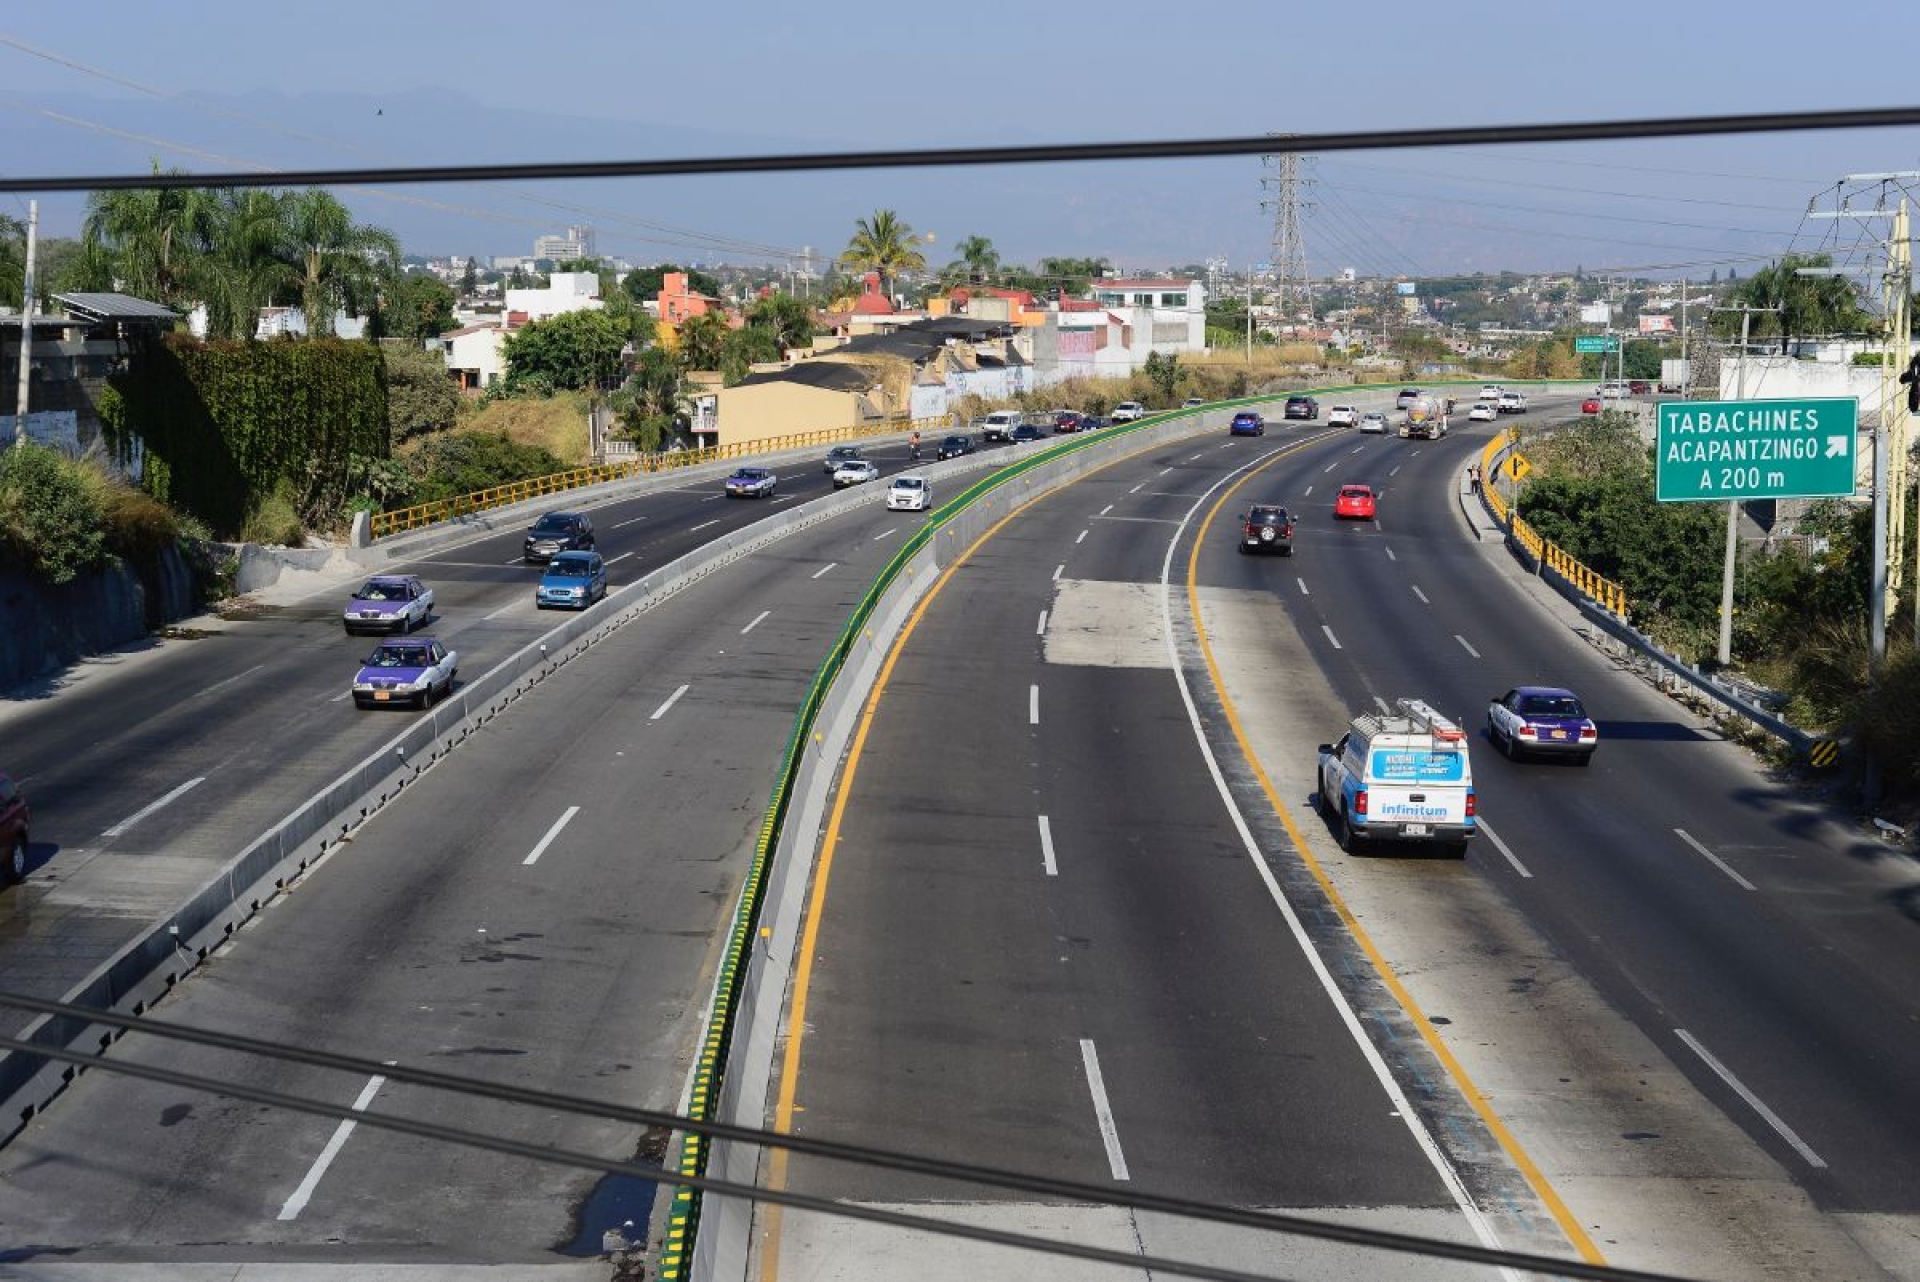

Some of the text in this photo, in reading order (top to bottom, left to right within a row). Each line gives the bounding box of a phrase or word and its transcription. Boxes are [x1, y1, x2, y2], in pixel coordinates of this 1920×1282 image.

[1668, 410, 1818, 434] TABACHINES
[1667, 438, 1818, 462] ACAPANTZINGO
[1700, 467, 1785, 490] A 200 m
[1382, 803, 1447, 816] infinitum
